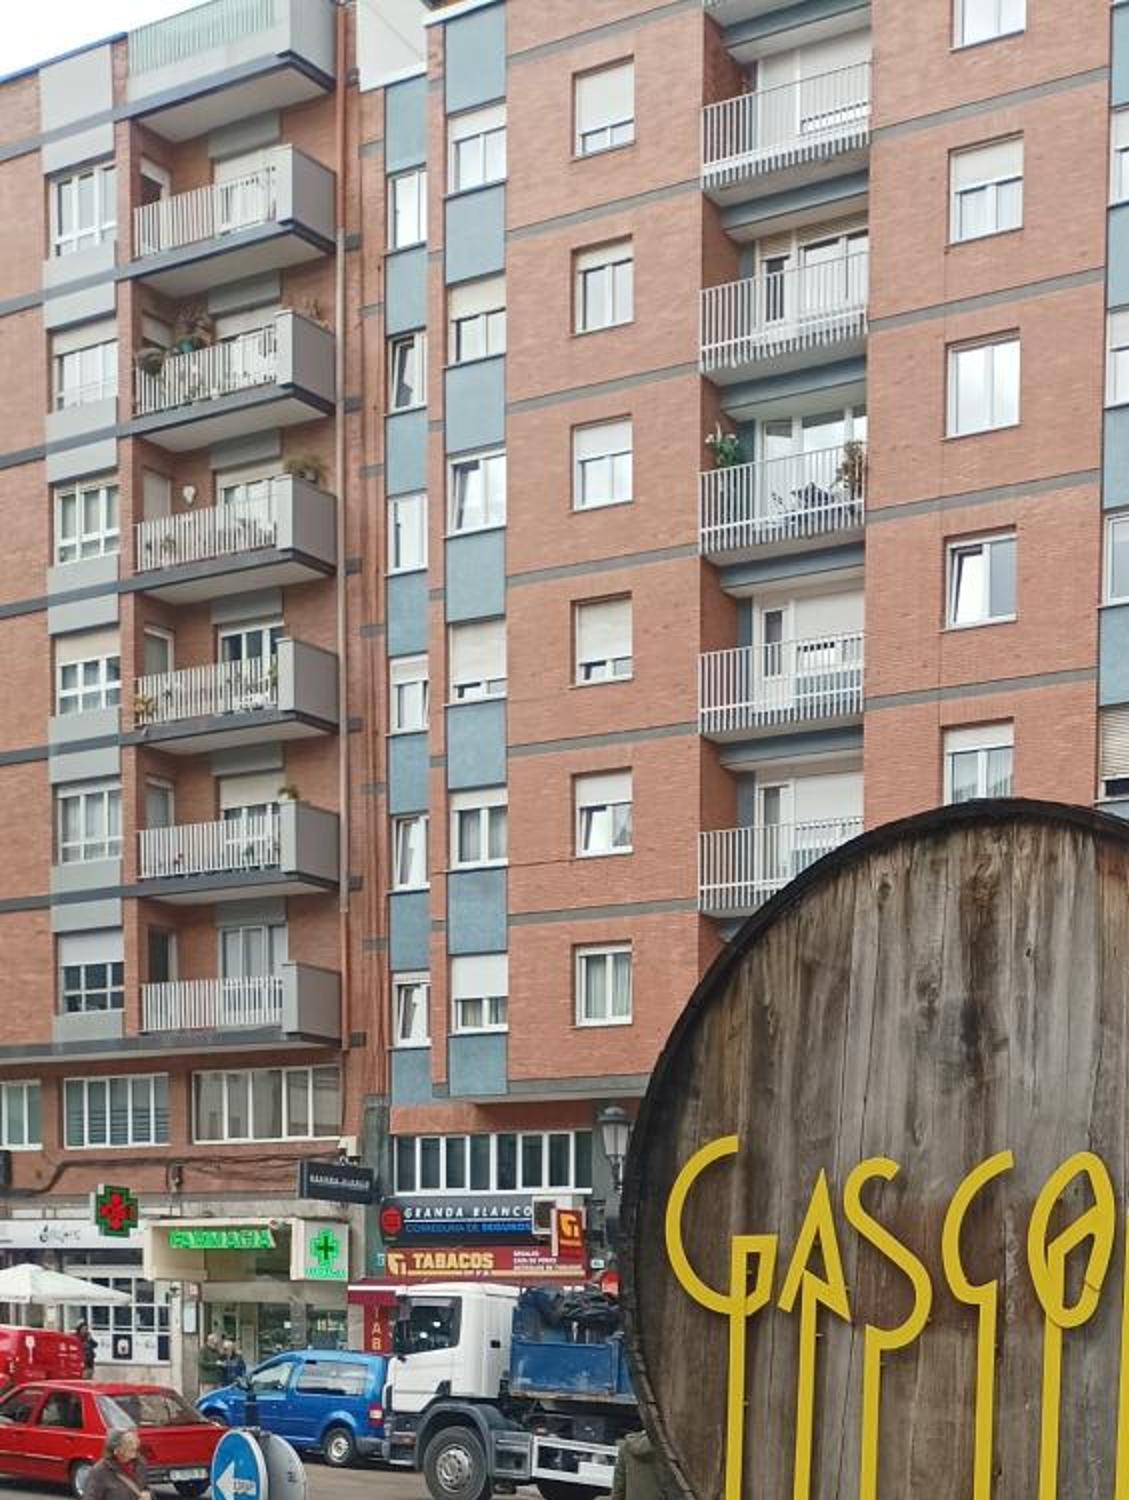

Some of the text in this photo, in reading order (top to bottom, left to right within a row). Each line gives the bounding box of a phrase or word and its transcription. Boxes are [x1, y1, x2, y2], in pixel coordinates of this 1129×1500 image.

[403, 1205, 532, 1219] GRANDA BLANCO
[169, 1229, 276, 1249] FARMACIA
[412, 1253, 495, 1269] TABACOS
